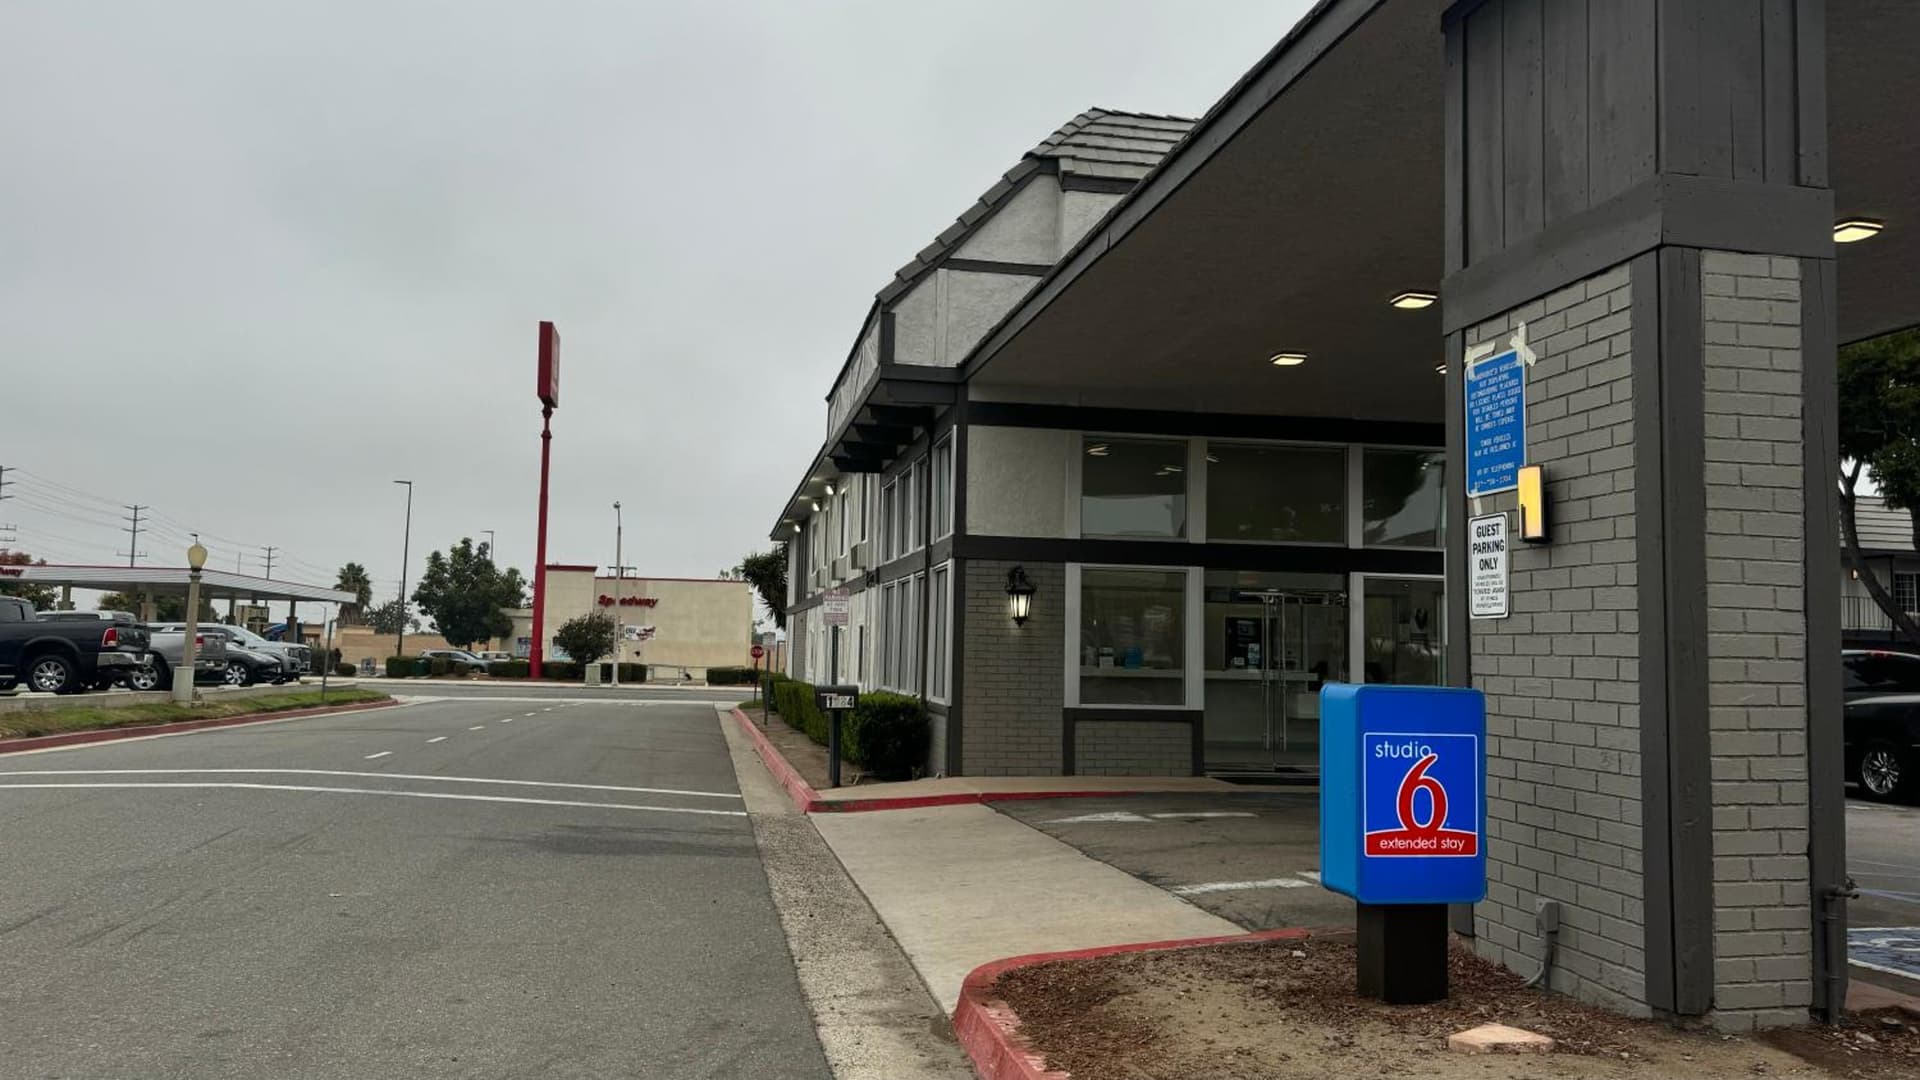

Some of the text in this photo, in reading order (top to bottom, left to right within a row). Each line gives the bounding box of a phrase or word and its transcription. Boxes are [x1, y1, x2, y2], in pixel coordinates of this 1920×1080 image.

[1476, 523, 1501, 538] GUEST
[1473, 540, 1505, 555] PARKING
[1479, 557, 1499, 571] ONLY
[1375, 741, 1432, 759] studio
[1396, 753, 1449, 831] 6
[1380, 836, 1465, 852] extended stay
